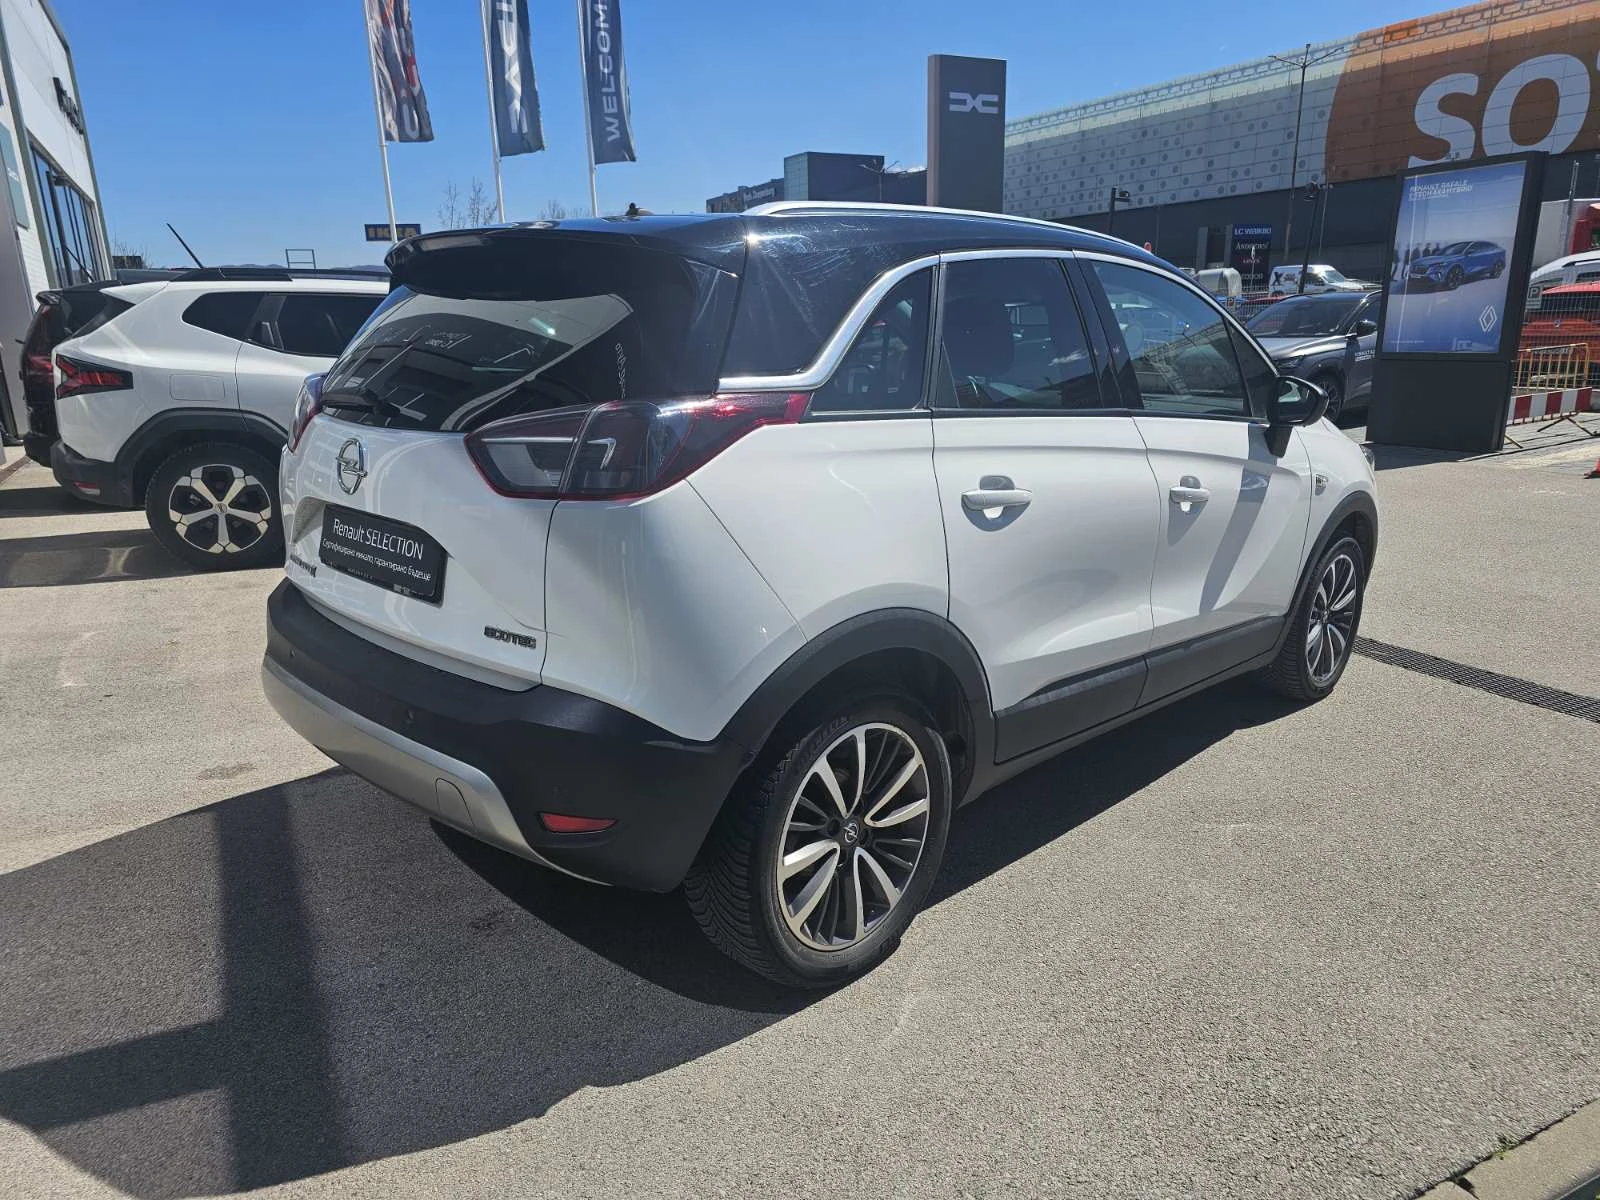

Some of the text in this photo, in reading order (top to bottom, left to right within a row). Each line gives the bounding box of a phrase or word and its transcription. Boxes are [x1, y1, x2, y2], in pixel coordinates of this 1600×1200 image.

[1408, 50, 1600, 168] SO
[333, 518, 424, 560] Renault SELECTION
